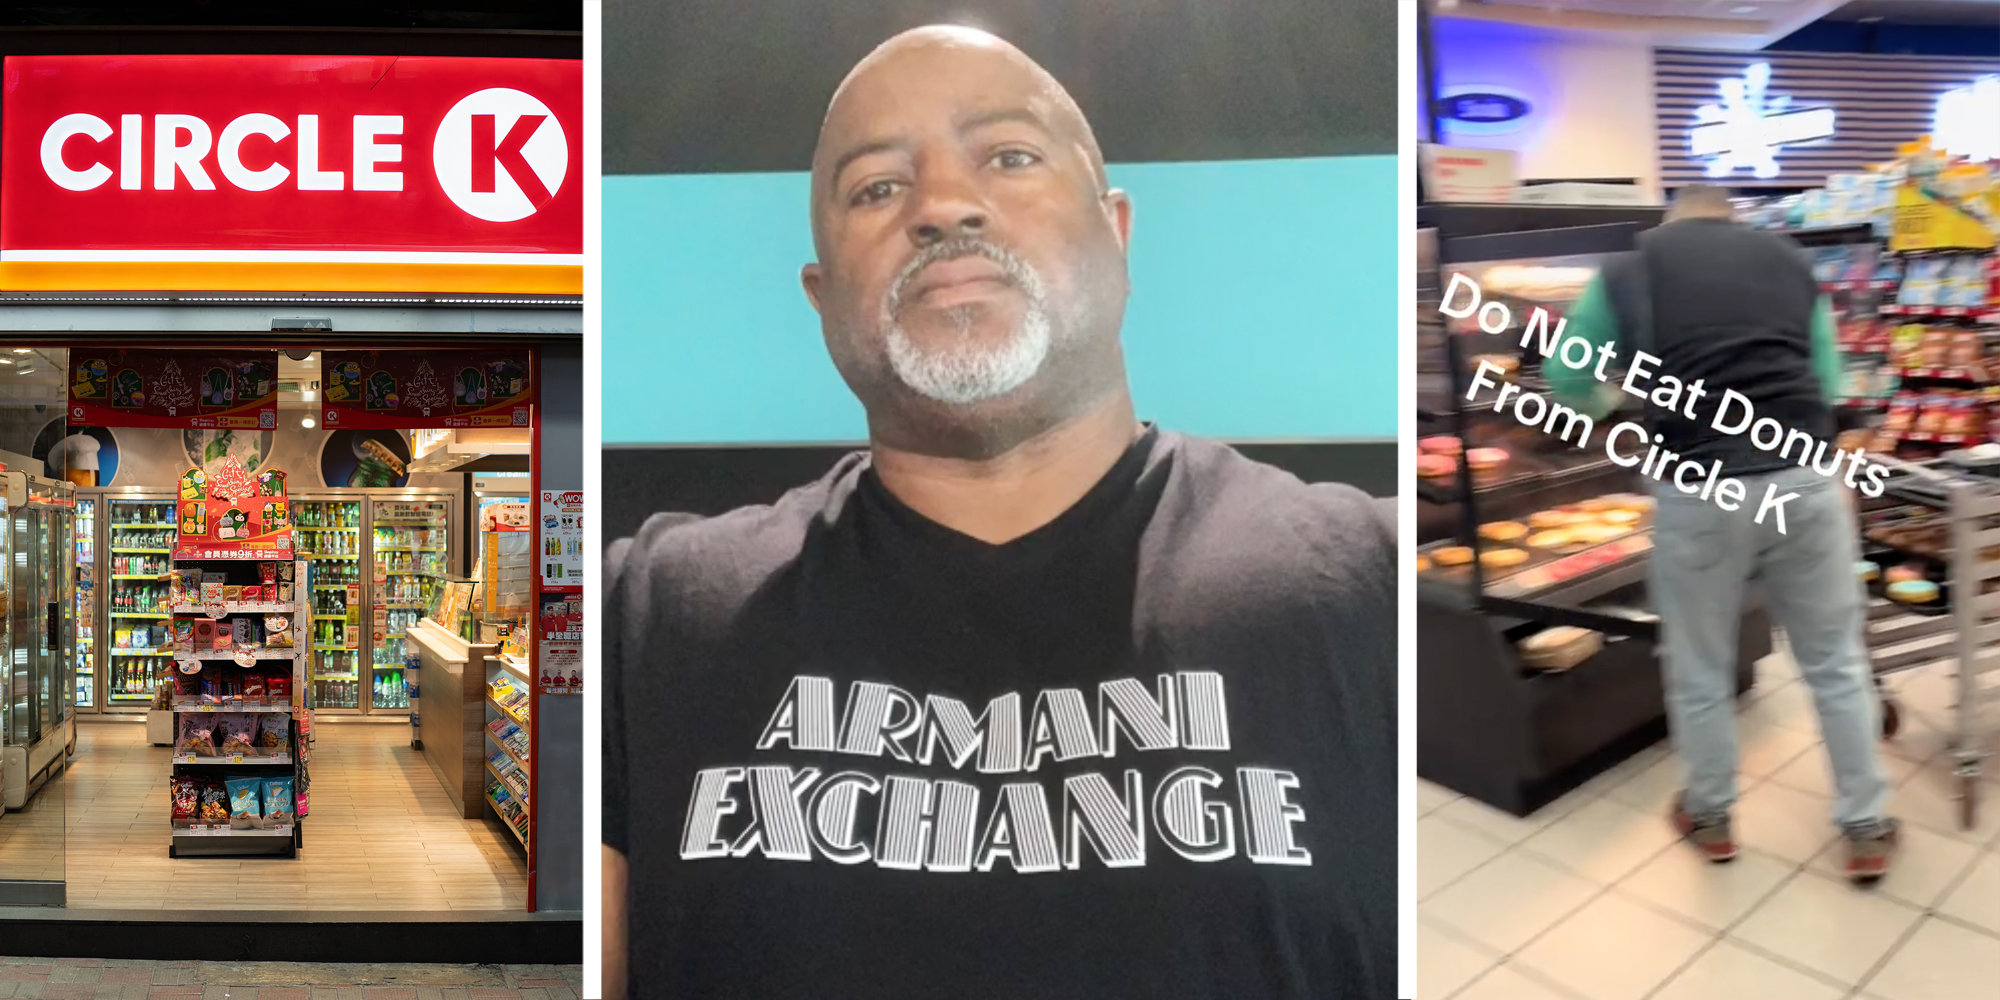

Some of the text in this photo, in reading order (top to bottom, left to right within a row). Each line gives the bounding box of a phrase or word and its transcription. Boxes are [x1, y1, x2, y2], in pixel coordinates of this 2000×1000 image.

[40, 112, 404, 192] CIRCLE
[160, 371, 183, 387] Gift
[221, 466, 242, 480] Gift
[755, 671, 1230, 773] ARMANI
[680, 765, 1312, 872] EXCHANGE
